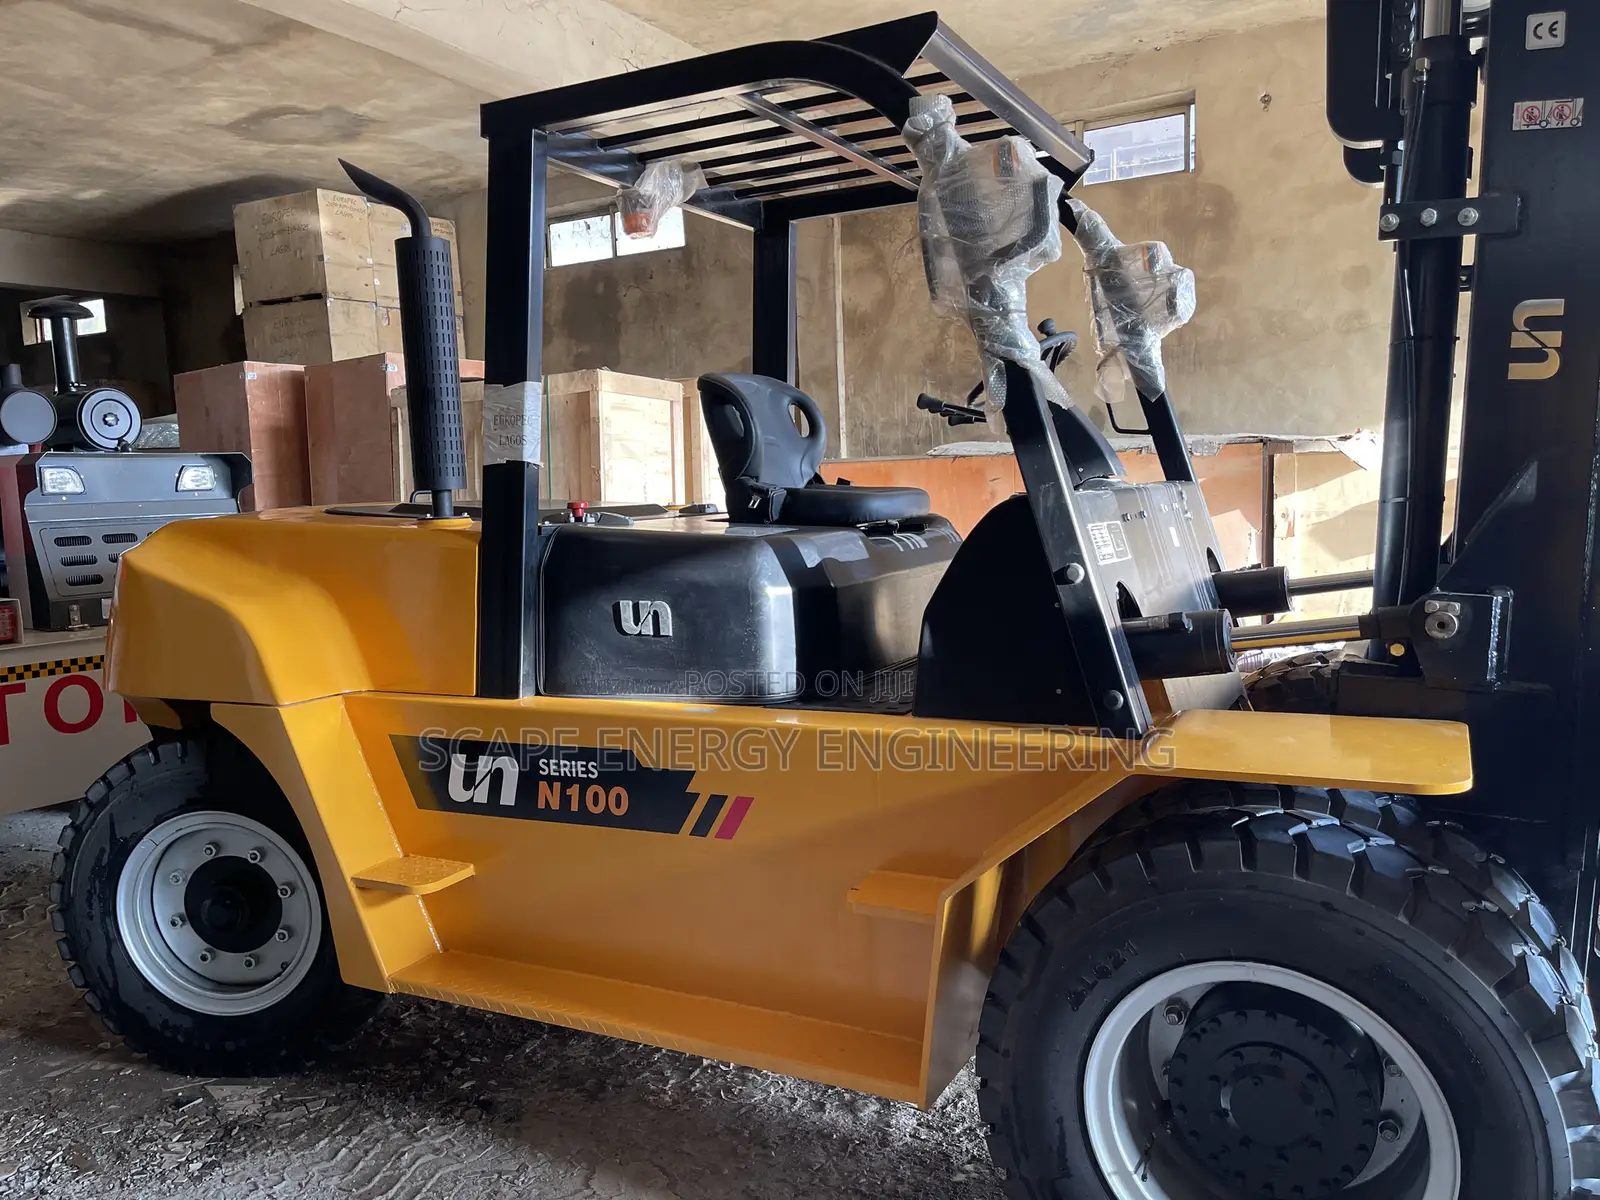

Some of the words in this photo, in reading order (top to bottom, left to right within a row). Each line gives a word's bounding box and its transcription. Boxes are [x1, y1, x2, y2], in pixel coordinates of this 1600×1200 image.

[1533, 20, 1559, 40] CE
[499, 434, 528, 446] LAGOS
[538, 757, 599, 779] SERIES
[537, 780, 629, 816] N100
